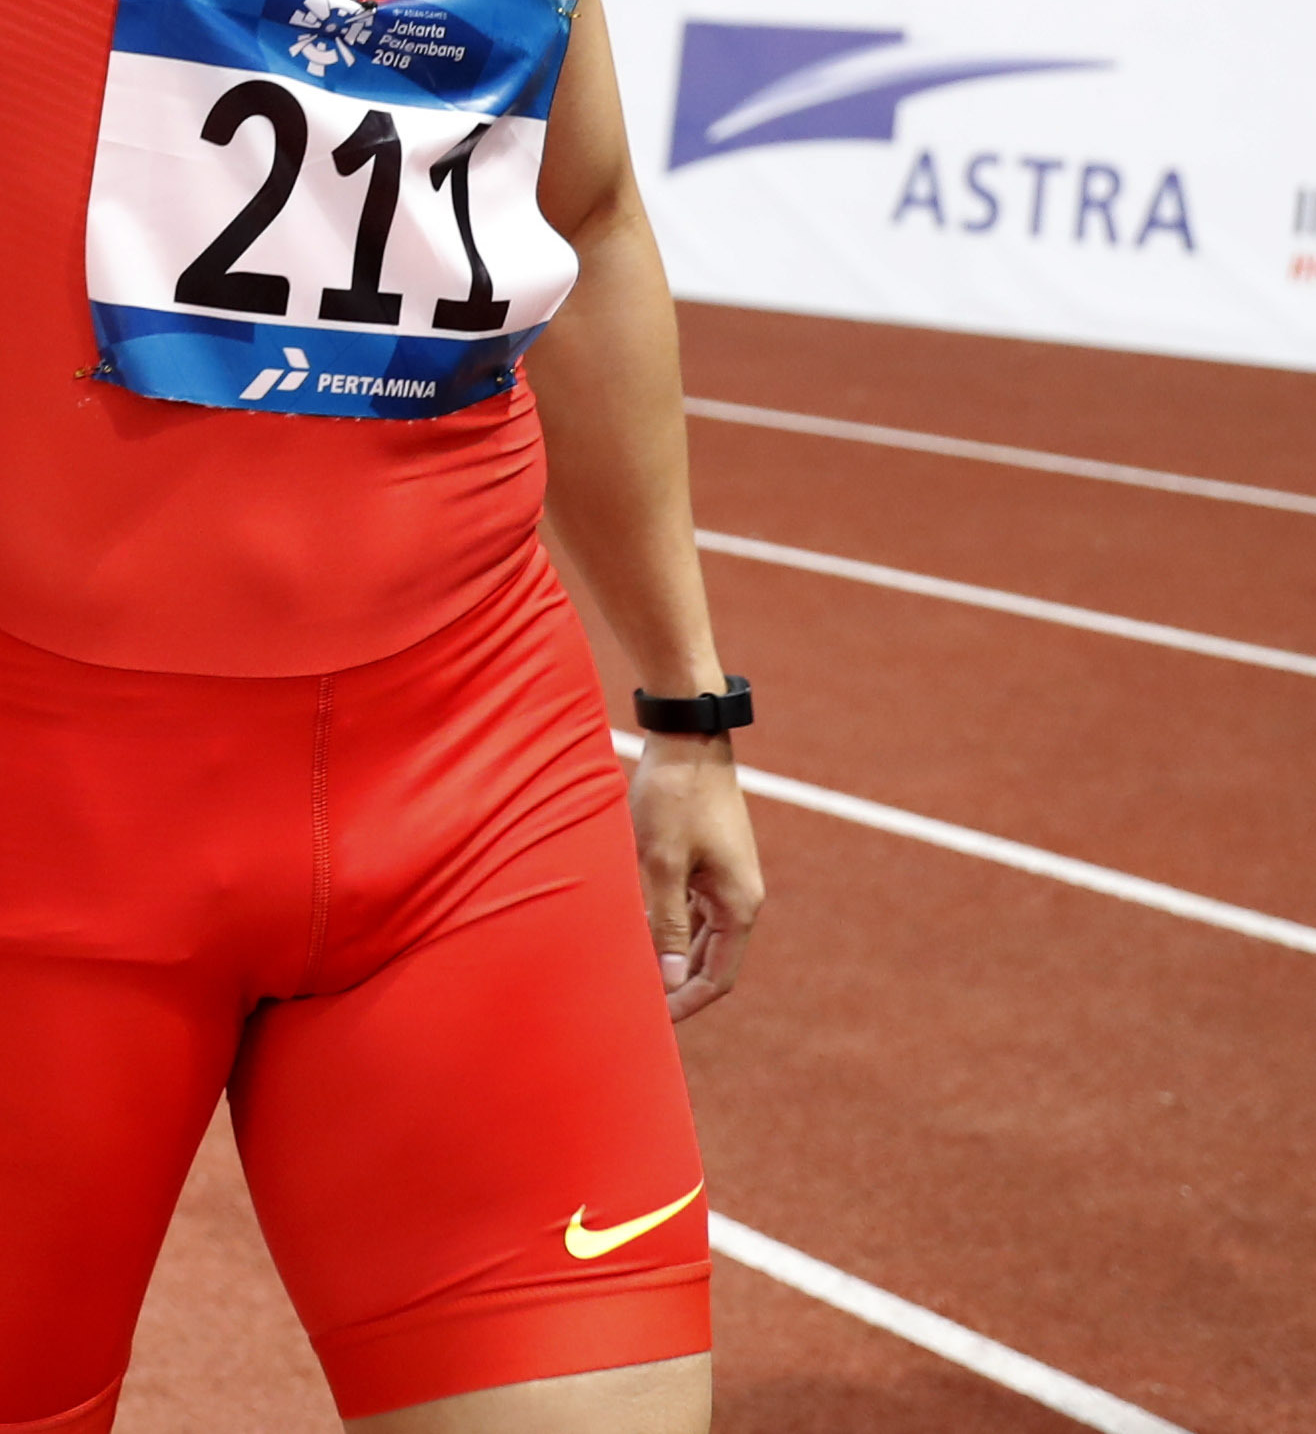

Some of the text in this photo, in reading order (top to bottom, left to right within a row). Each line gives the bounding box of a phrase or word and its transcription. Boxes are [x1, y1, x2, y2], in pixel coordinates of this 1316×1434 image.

[387, 19, 446, 39] Jakarta
[372, 49, 411, 69] 2018
[378, 34, 466, 62] Palembang
[174, 79, 510, 333] 211
[890, 149, 1196, 252] ASTRA
[317, 373, 437, 399] PERTAMINA
